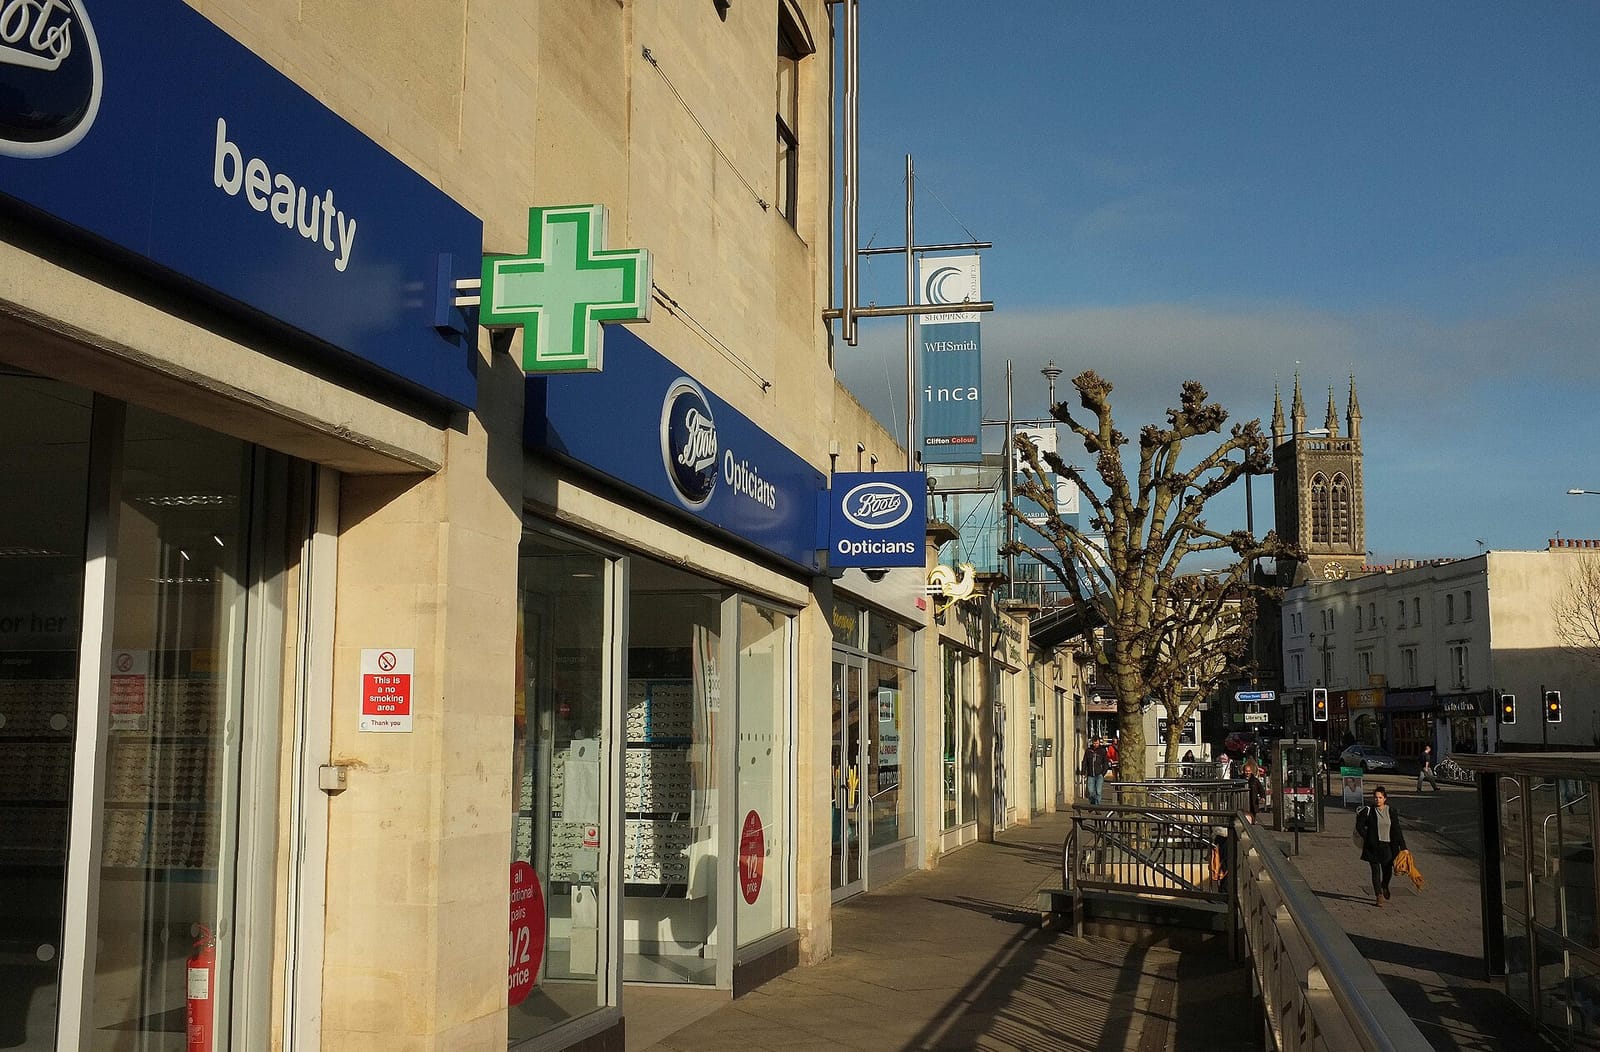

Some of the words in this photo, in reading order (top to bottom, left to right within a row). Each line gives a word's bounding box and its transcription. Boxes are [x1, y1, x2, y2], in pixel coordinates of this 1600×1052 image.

[0, 0, 72, 71] ots
[213, 117, 357, 272] beauty
[924, 313, 968, 322] SHOPPING
[924, 340, 977, 352] WHSmith
[924, 385, 979, 402] inca
[678, 407, 718, 472] Boots
[926, 436, 950, 445] Clifton
[951, 435, 975, 444] Colour
[723, 449, 776, 510] Opticians
[853, 493, 901, 518] Boots
[837, 539, 915, 556] Opticians
[0, 615, 25, 633] or
[31, 611, 67, 632] her
[373, 676, 390, 684] This
[393, 676, 400, 684] is
[369, 695, 404, 703] smoking
[514, 869, 523, 884] all
[511, 905, 526, 925] pairs
